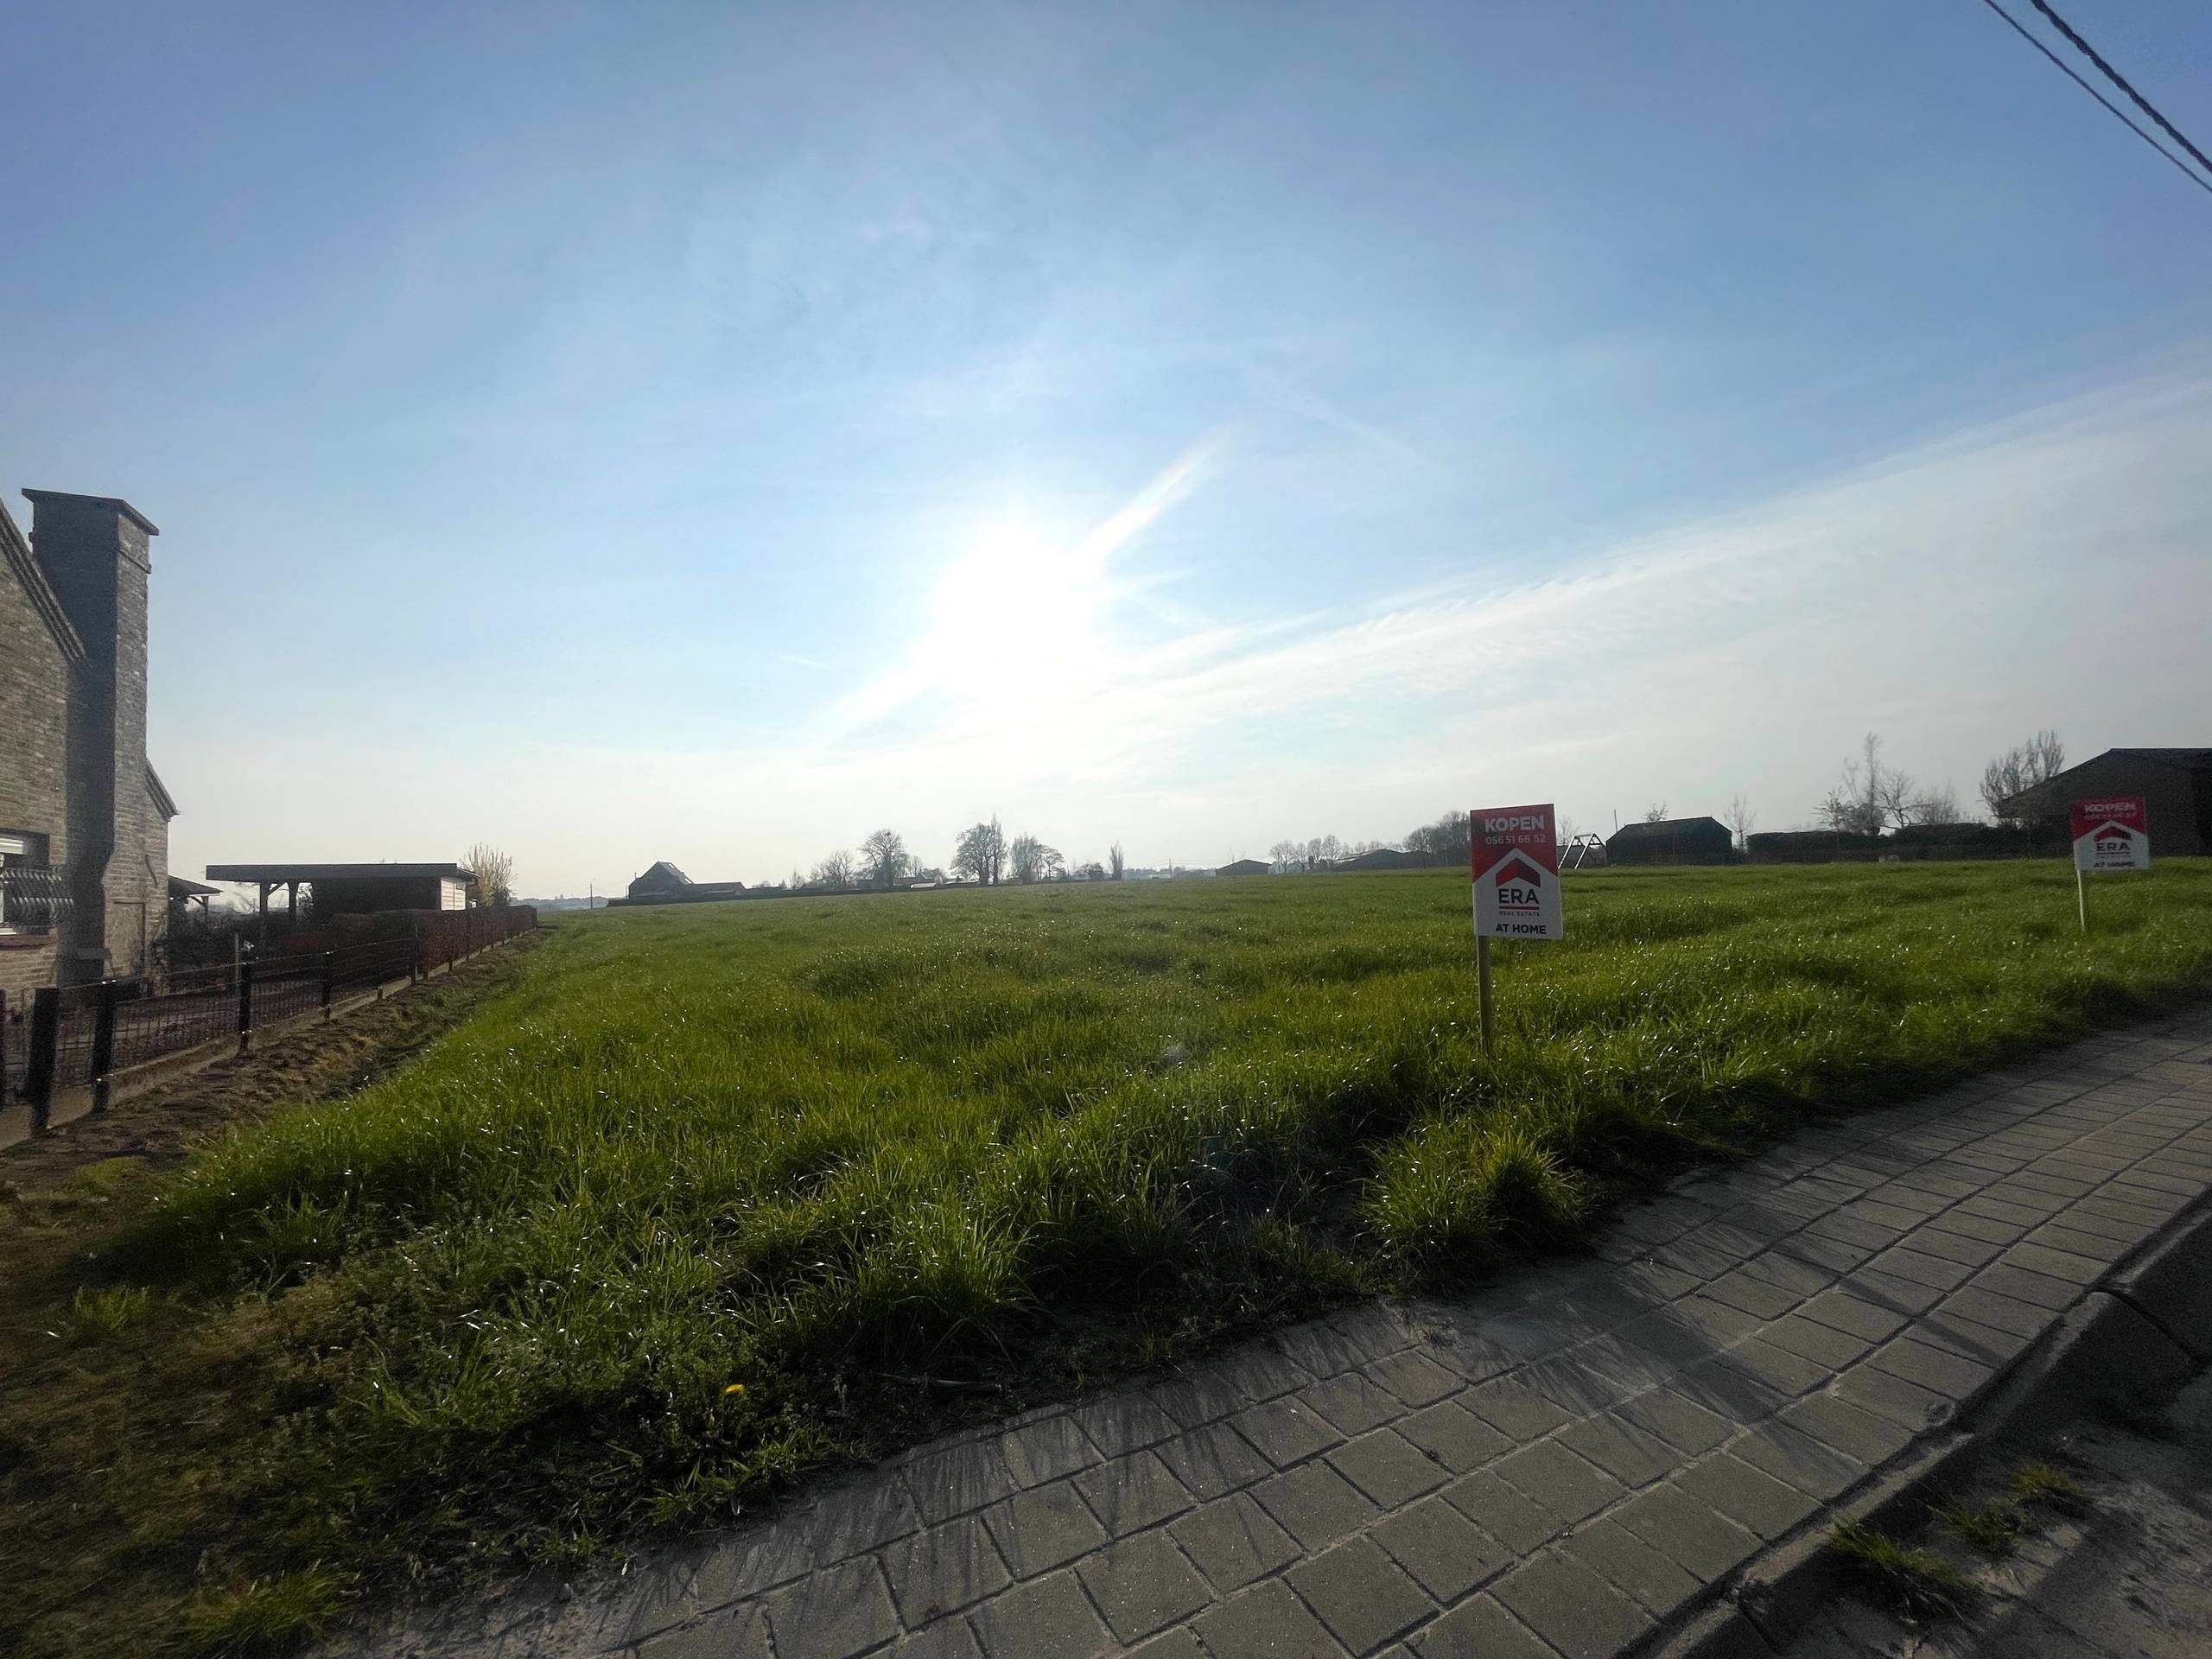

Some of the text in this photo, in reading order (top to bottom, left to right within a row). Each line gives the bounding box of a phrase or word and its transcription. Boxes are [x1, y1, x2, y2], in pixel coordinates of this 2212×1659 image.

[2084, 802, 2136, 812] KOPEN
[1484, 815, 1545, 833] KOPEN
[1485, 834, 1547, 845] 056 51 66 52
[2096, 842, 2131, 851] ERA
[1498, 888, 1540, 905] ERA
[1496, 924, 1547, 934] AT HOME
